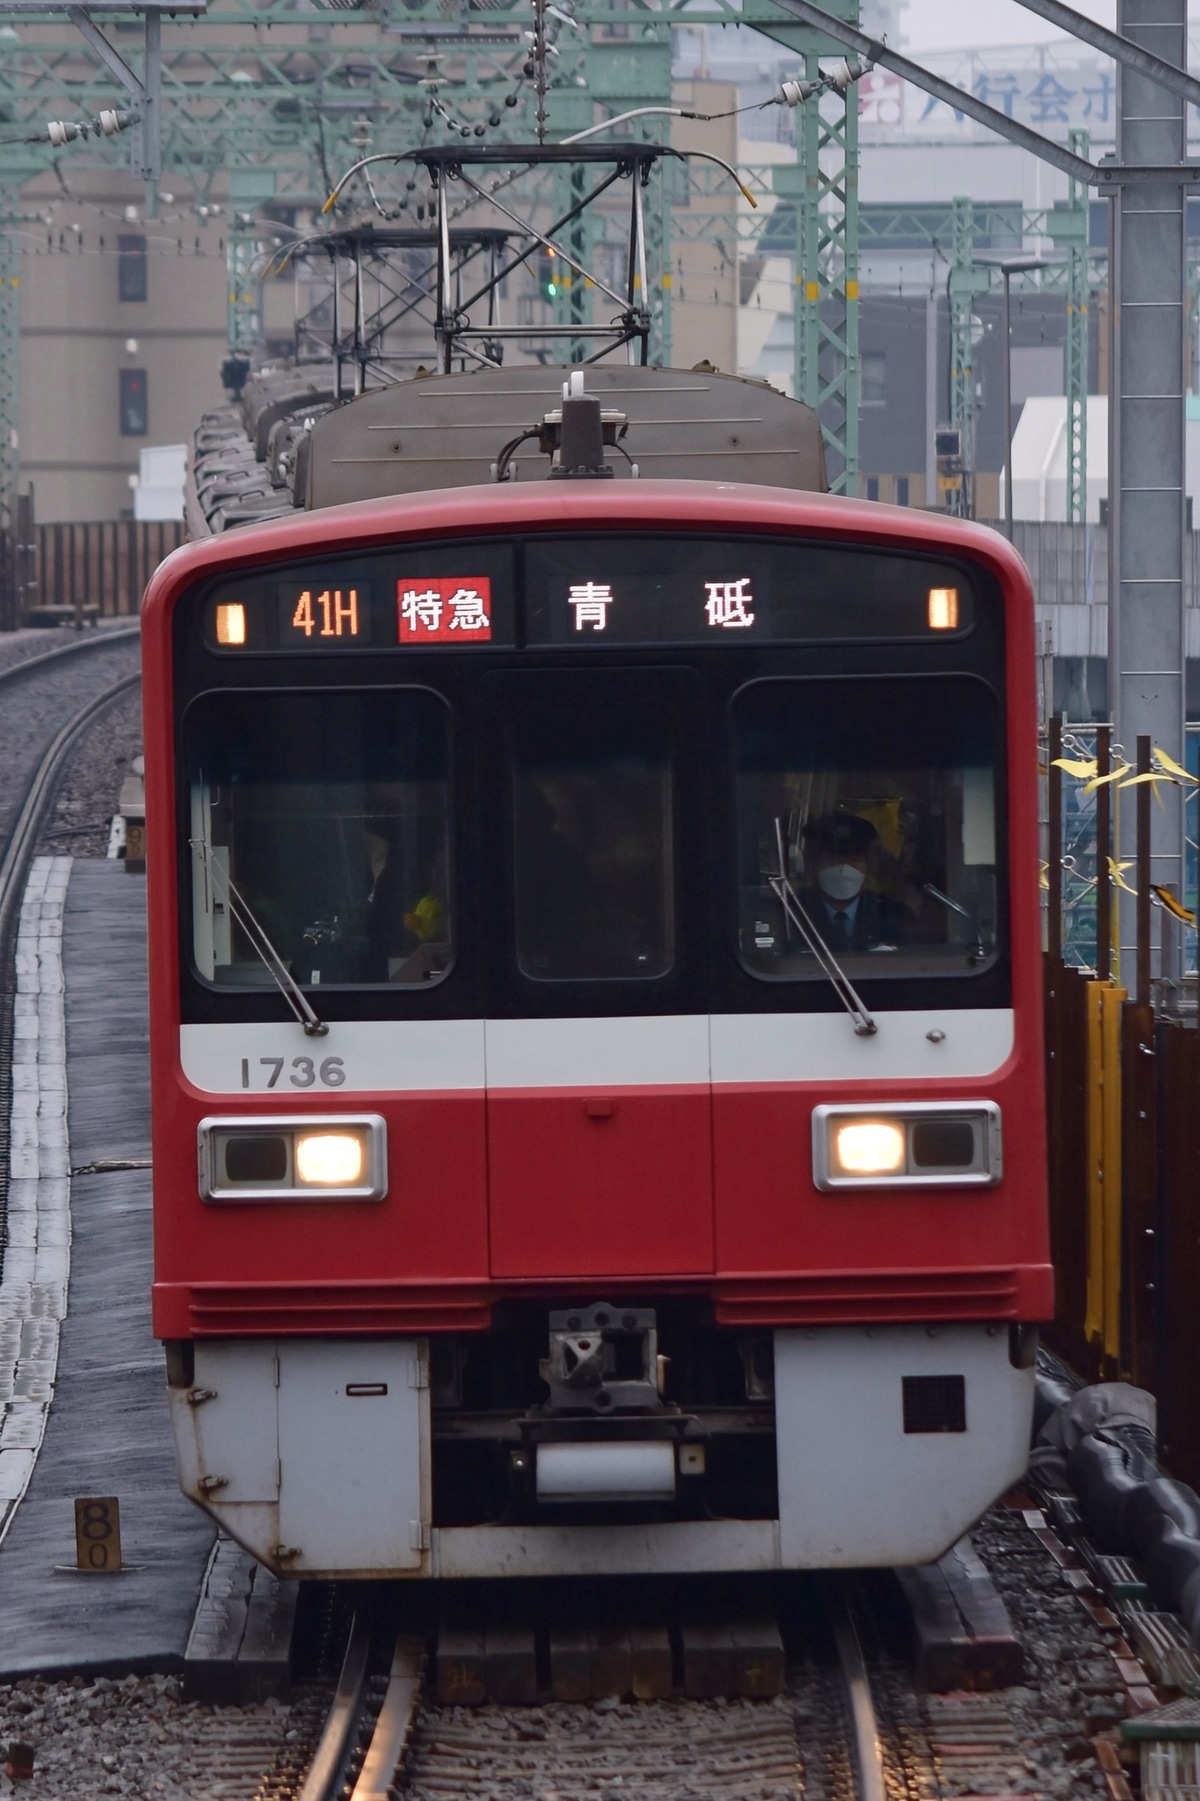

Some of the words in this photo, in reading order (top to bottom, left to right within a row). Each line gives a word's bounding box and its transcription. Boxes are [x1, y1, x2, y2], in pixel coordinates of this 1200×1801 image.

[292, 589, 359, 637] 41H
[401, 588, 490, 632] 特急
[241, 1056, 346, 1088] 1736
